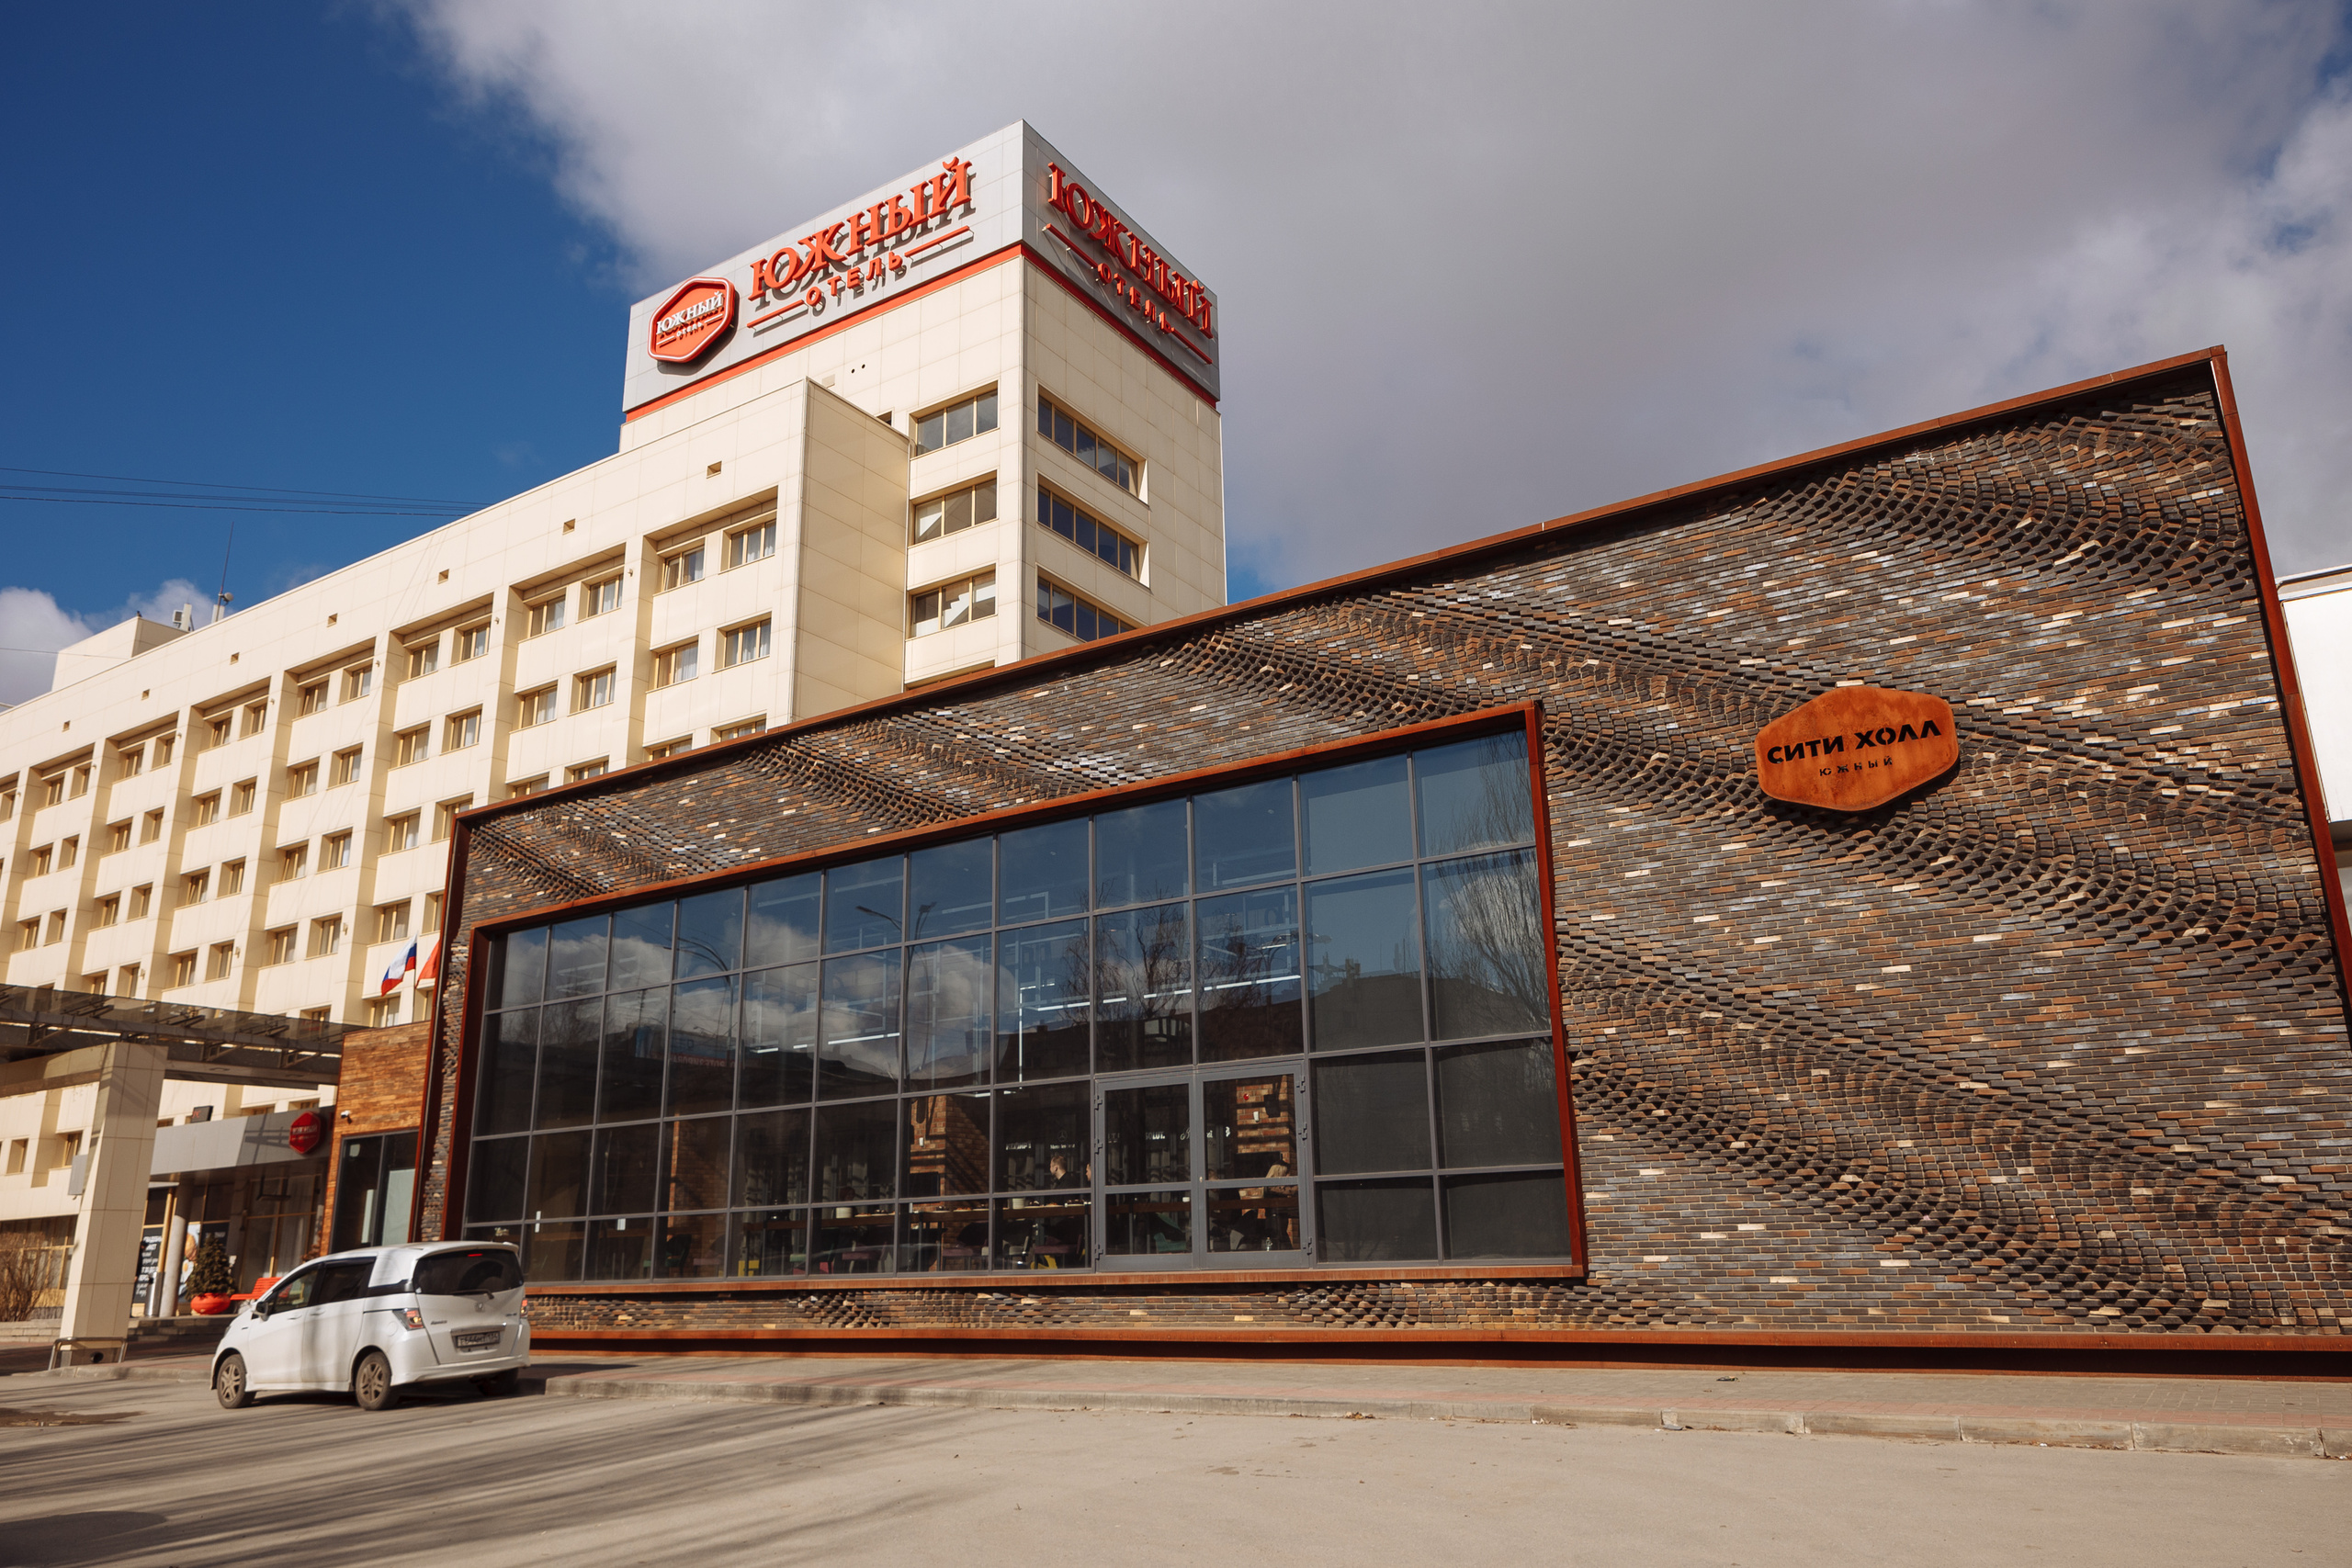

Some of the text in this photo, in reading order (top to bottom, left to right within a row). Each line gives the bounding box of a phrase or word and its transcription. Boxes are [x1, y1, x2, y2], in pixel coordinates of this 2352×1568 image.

[747, 156, 973, 301] ЮЖНЫЙ
[1047, 162, 1214, 339] ЮЖНЫЙ
[806, 251, 903, 307] ОТЕЛЬ
[1097, 263, 1172, 334] ОТЕЛЬ
[656, 290, 724, 335] ЮЖНЫЙ
[1767, 719, 1942, 764] СИТИ ХОЛЛ
[1818, 755, 1893, 777] ЮЖНЫЙ
